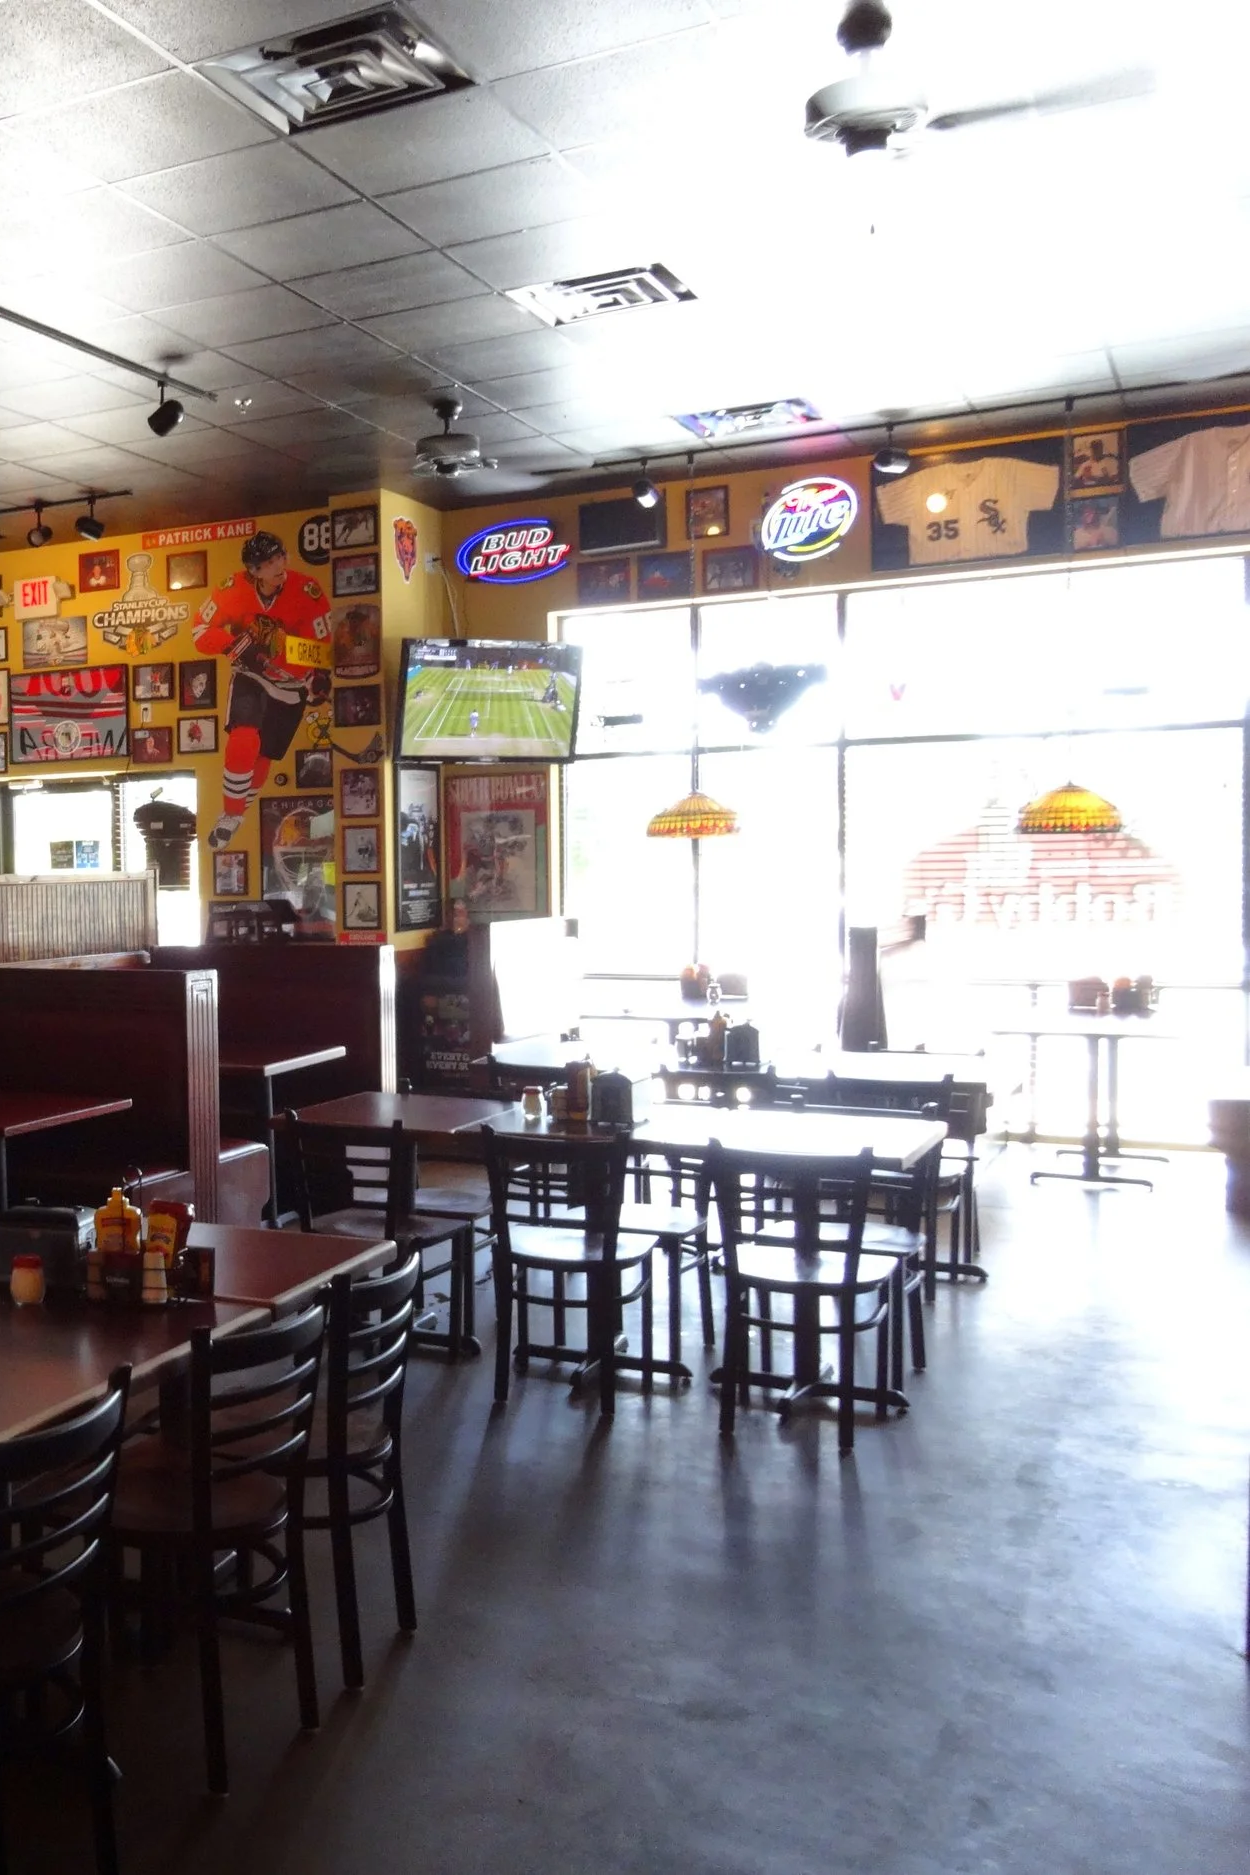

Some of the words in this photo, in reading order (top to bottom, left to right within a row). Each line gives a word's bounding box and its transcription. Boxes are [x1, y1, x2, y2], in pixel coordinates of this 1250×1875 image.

[158, 526, 212, 546] PATRICK
[217, 522, 253, 538] KANE
[482, 527, 552, 553] BUD
[926, 518, 960, 542] 35
[470, 545, 569, 577] LIGHT
[21, 580, 49, 608] EXIT
[113, 600, 149, 611] STANLEY
[149, 598, 168, 607] CUP
[93, 604, 188, 628] CHAMPIONS
